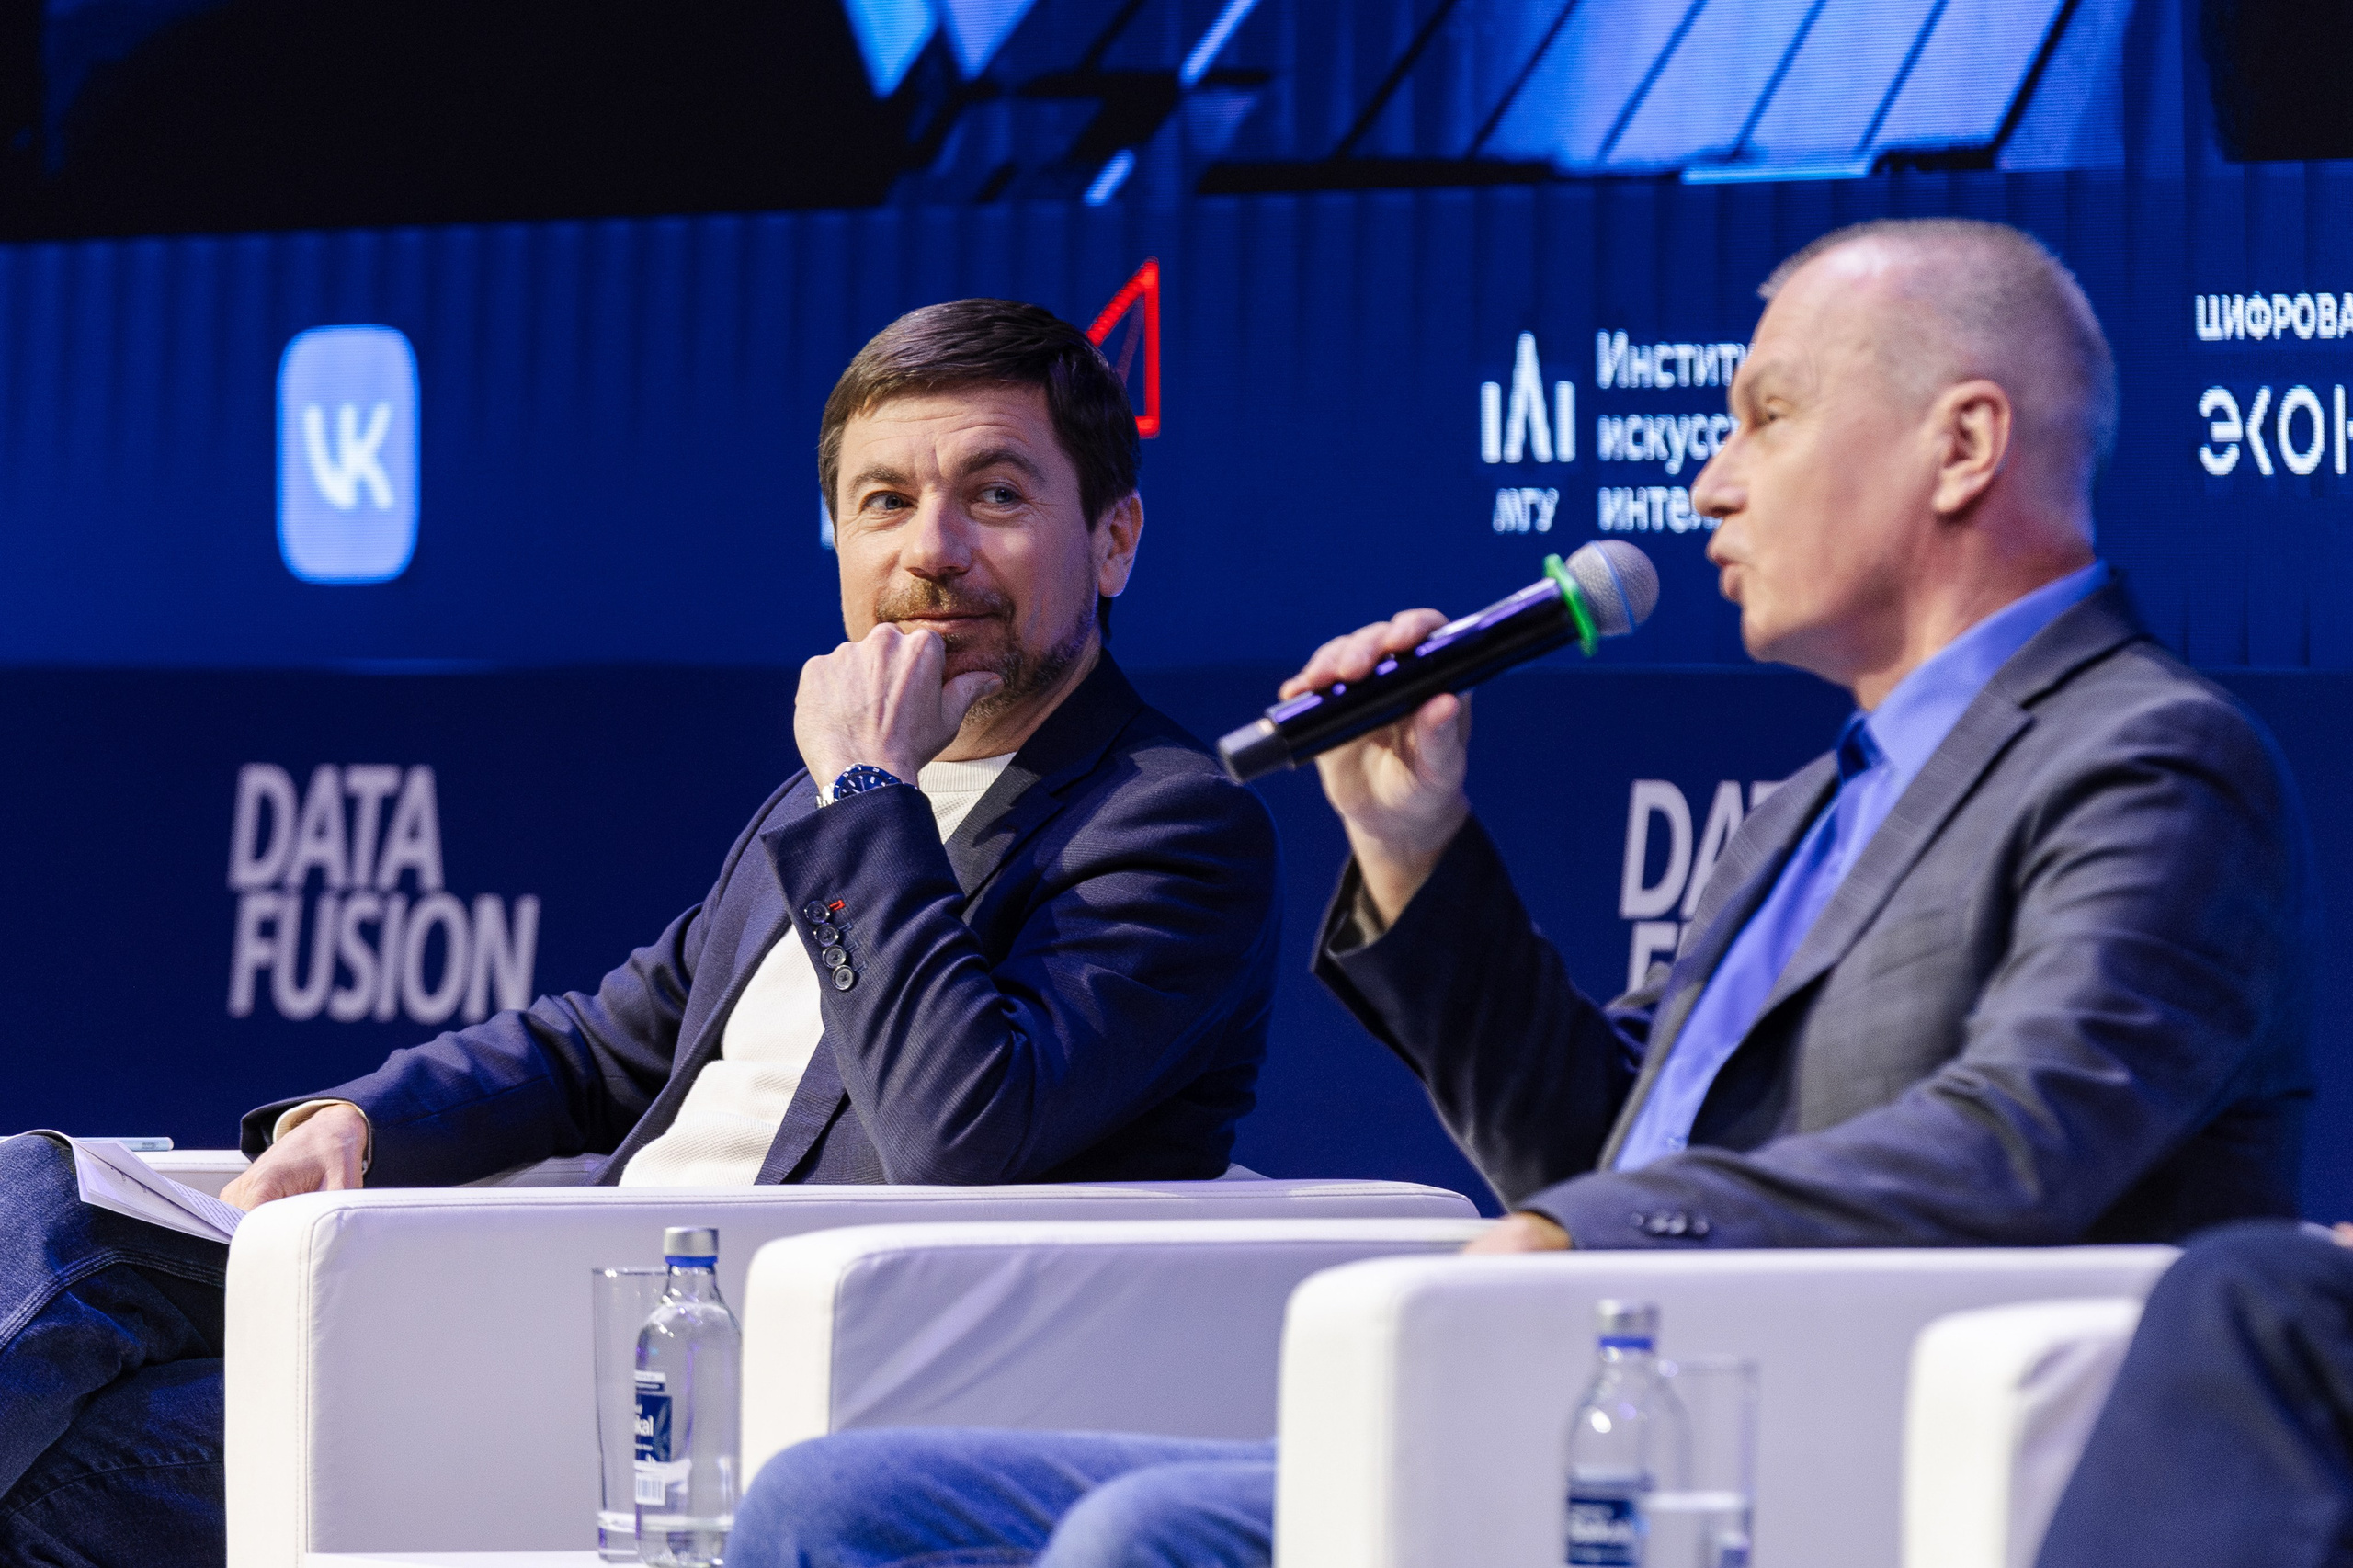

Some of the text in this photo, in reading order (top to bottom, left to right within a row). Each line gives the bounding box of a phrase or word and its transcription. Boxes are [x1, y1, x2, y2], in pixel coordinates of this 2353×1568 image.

[302, 403, 393, 510] VK
[1597, 414, 1741, 475] искусс
[228, 764, 443, 892] DATA
[1619, 778, 1788, 919] DA
[228, 892, 540, 1024] FUSION
